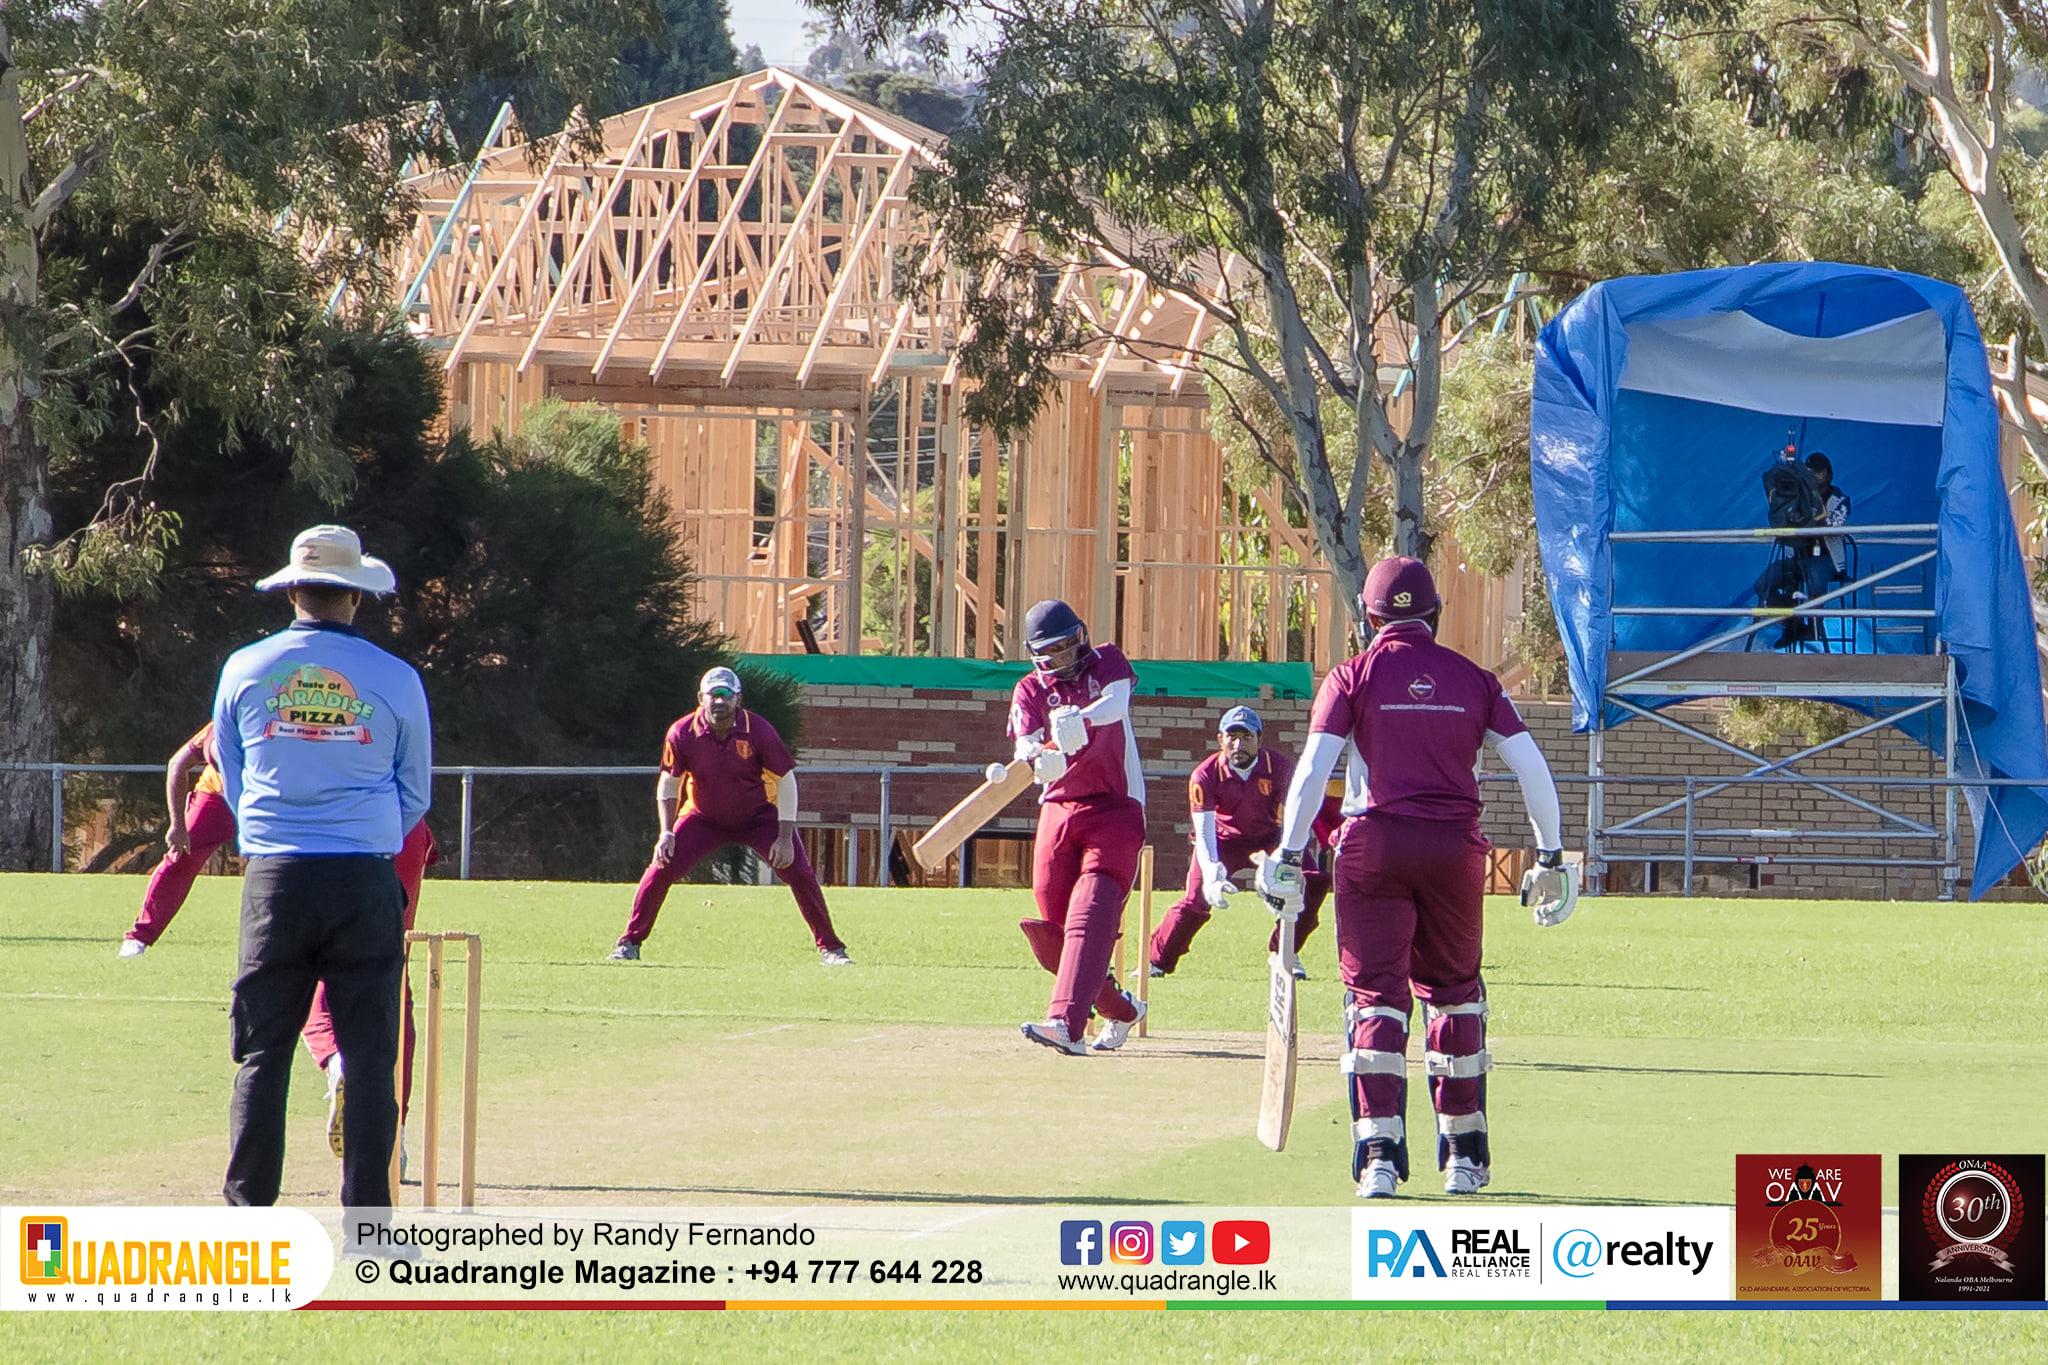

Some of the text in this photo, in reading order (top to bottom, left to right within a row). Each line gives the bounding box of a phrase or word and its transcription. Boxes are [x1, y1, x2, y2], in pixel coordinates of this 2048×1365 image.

[297, 680, 341, 689] Taste Of
[265, 690, 375, 720] PARADISE
[290, 711, 346, 725] PIZZA
